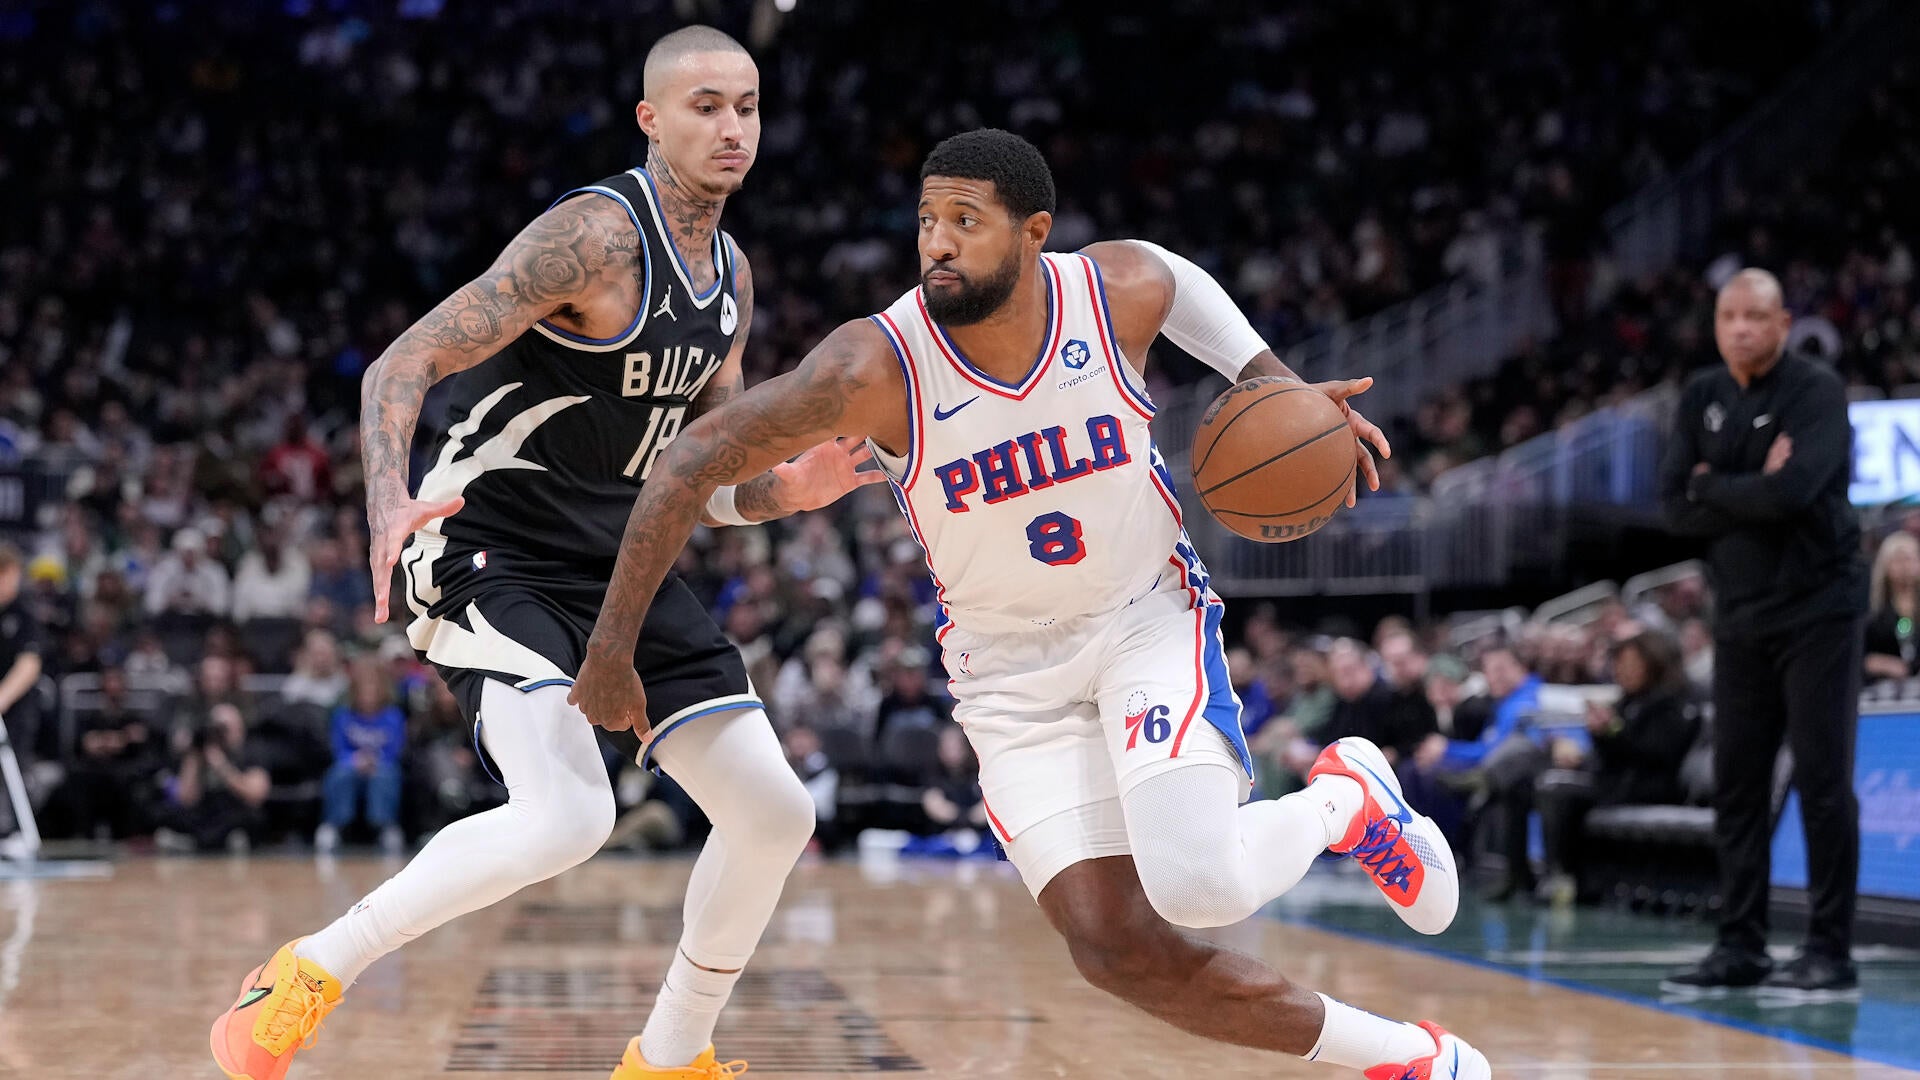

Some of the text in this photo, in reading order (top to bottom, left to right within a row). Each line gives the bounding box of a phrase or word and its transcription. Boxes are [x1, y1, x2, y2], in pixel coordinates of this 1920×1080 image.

[1058, 365, 1106, 390] crypto.com
[934, 414, 1131, 513] PHILA
[1025, 511, 1087, 566] 8
[1125, 704, 1172, 753] 76
